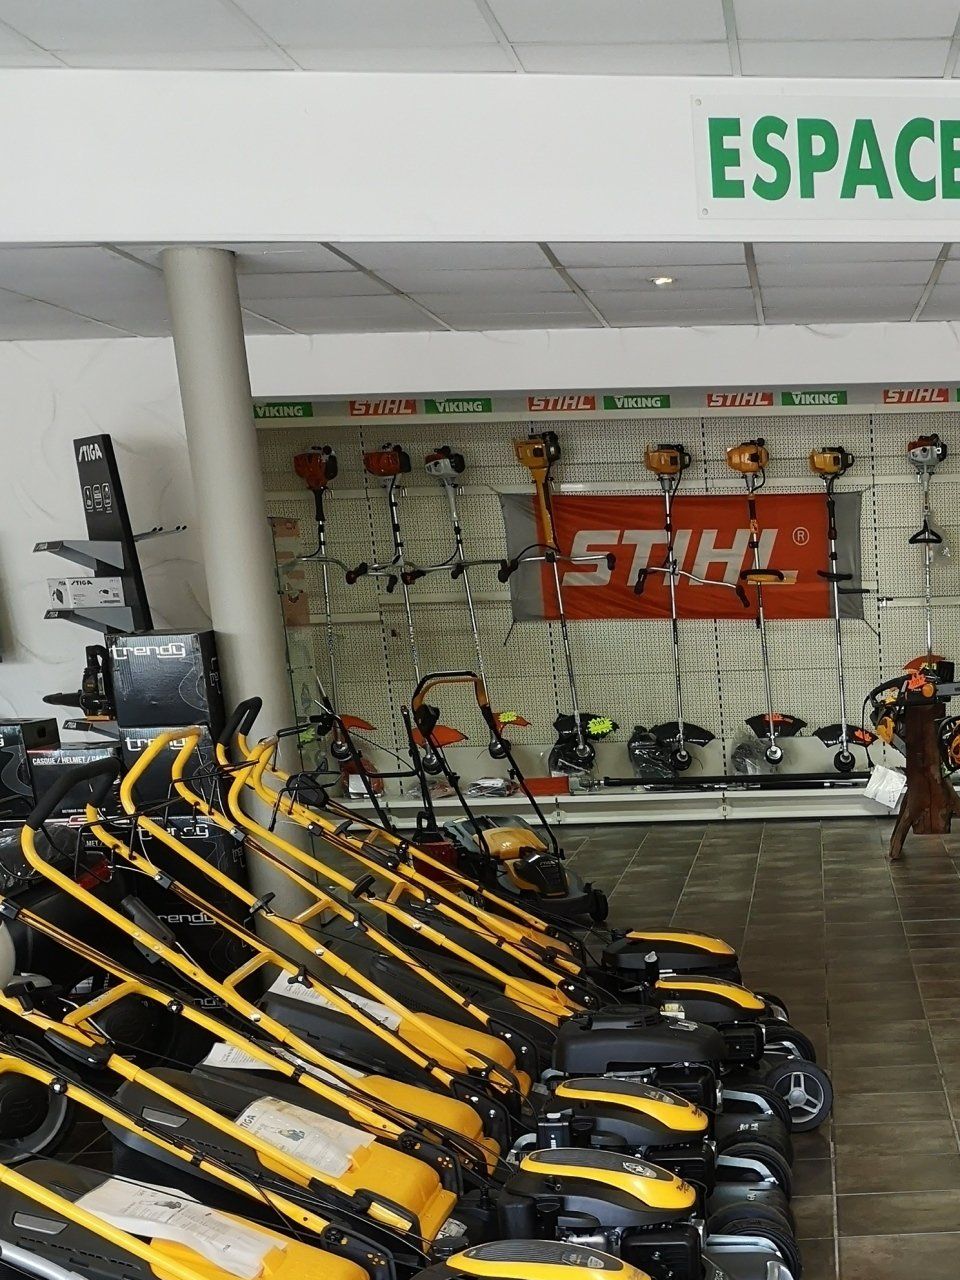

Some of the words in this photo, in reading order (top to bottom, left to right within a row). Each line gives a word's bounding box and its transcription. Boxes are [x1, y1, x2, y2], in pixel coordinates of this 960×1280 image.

[709, 391, 769, 406] STIHL
[791, 392, 838, 405] VIKING
[885, 388, 946, 402] STIHL
[352, 399, 413, 415] STIHL
[434, 400, 483, 413] VIKING
[531, 395, 592, 410] STIHL
[614, 396, 662, 409] VIKING
[255, 405, 303, 417] VIKING
[78, 443, 103, 463] STIGA
[561, 528, 799, 586] STIHL
[110, 642, 187, 660] trendy
[32, 757, 57, 765] CASQUE
[62, 756, 85, 764] HELMET
[157, 912, 216, 926] rendy
[240, 1114, 257, 1129] TIGA
